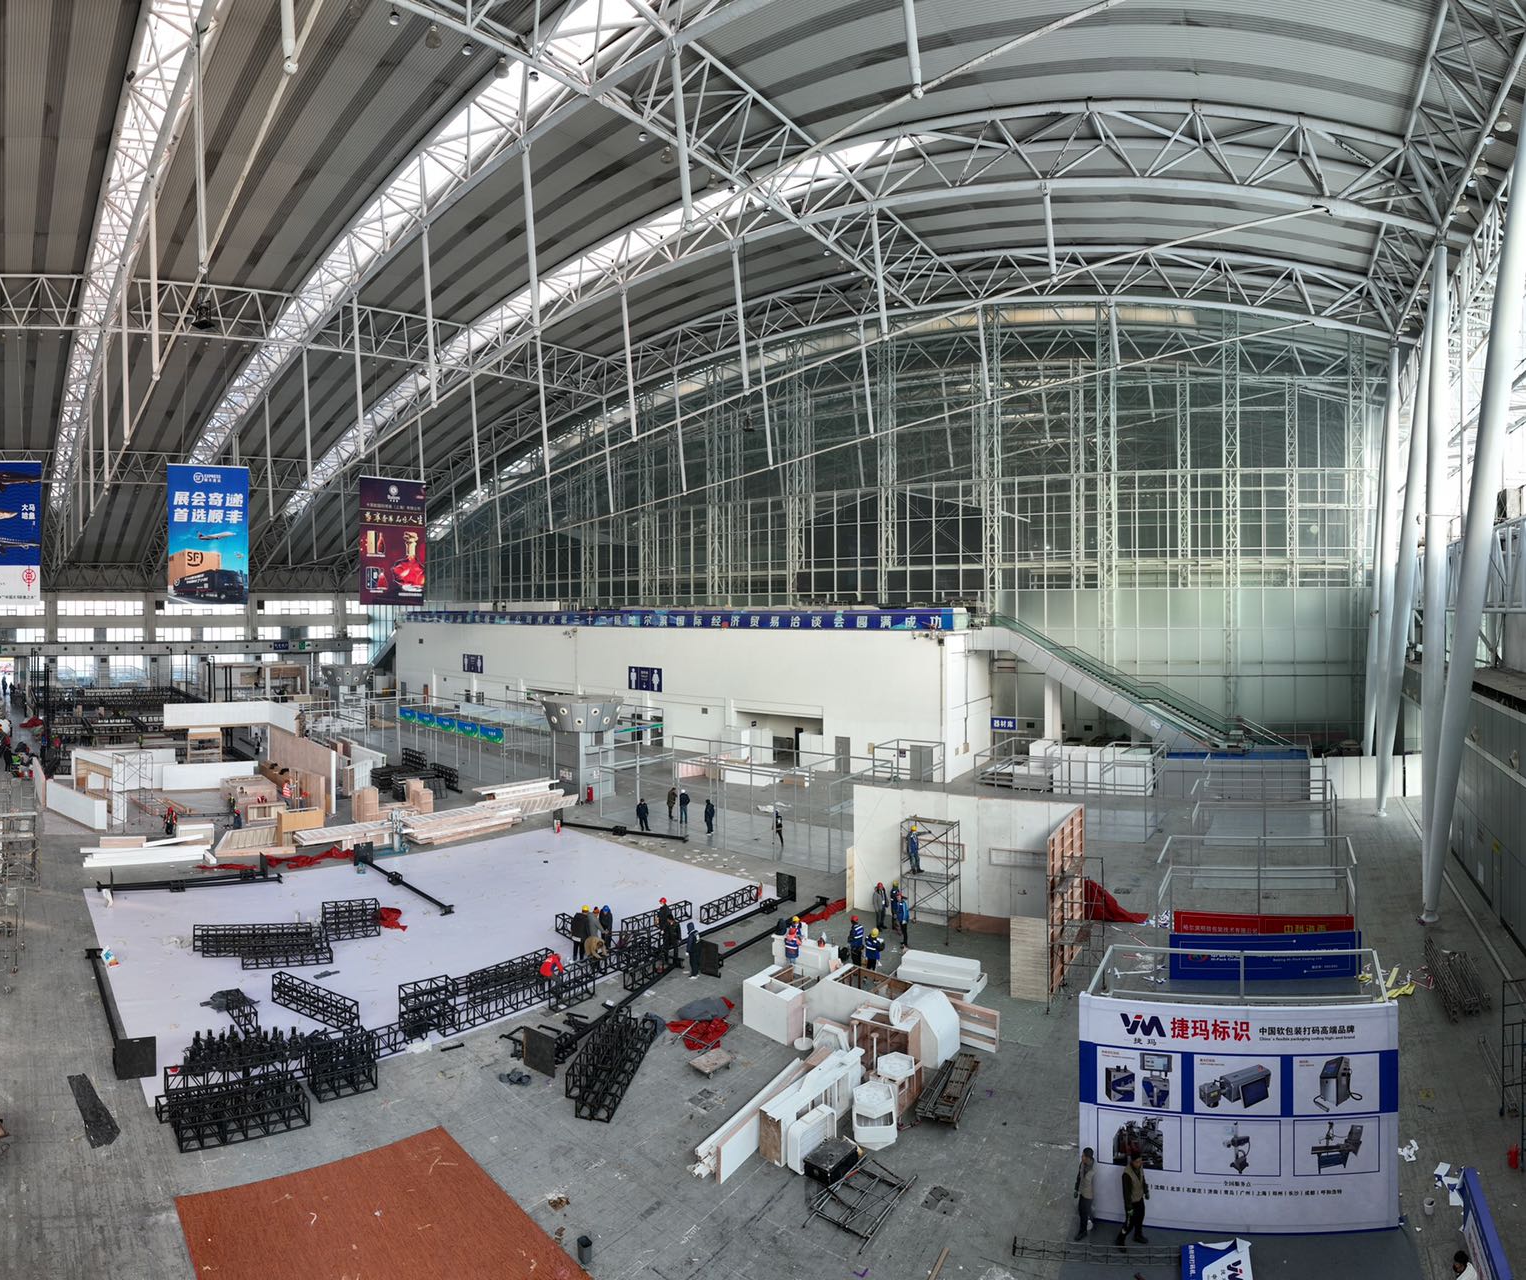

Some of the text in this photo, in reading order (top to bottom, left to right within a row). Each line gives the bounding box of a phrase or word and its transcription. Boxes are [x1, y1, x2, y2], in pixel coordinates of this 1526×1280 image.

[173, 491, 244, 507] 展会寄递
[173, 508, 243, 523] 首选顺丰
[1171, 1017, 1251, 1041] 捷玛标识
[1259, 1025, 1355, 1035] 中国软包装打码高端品牌
